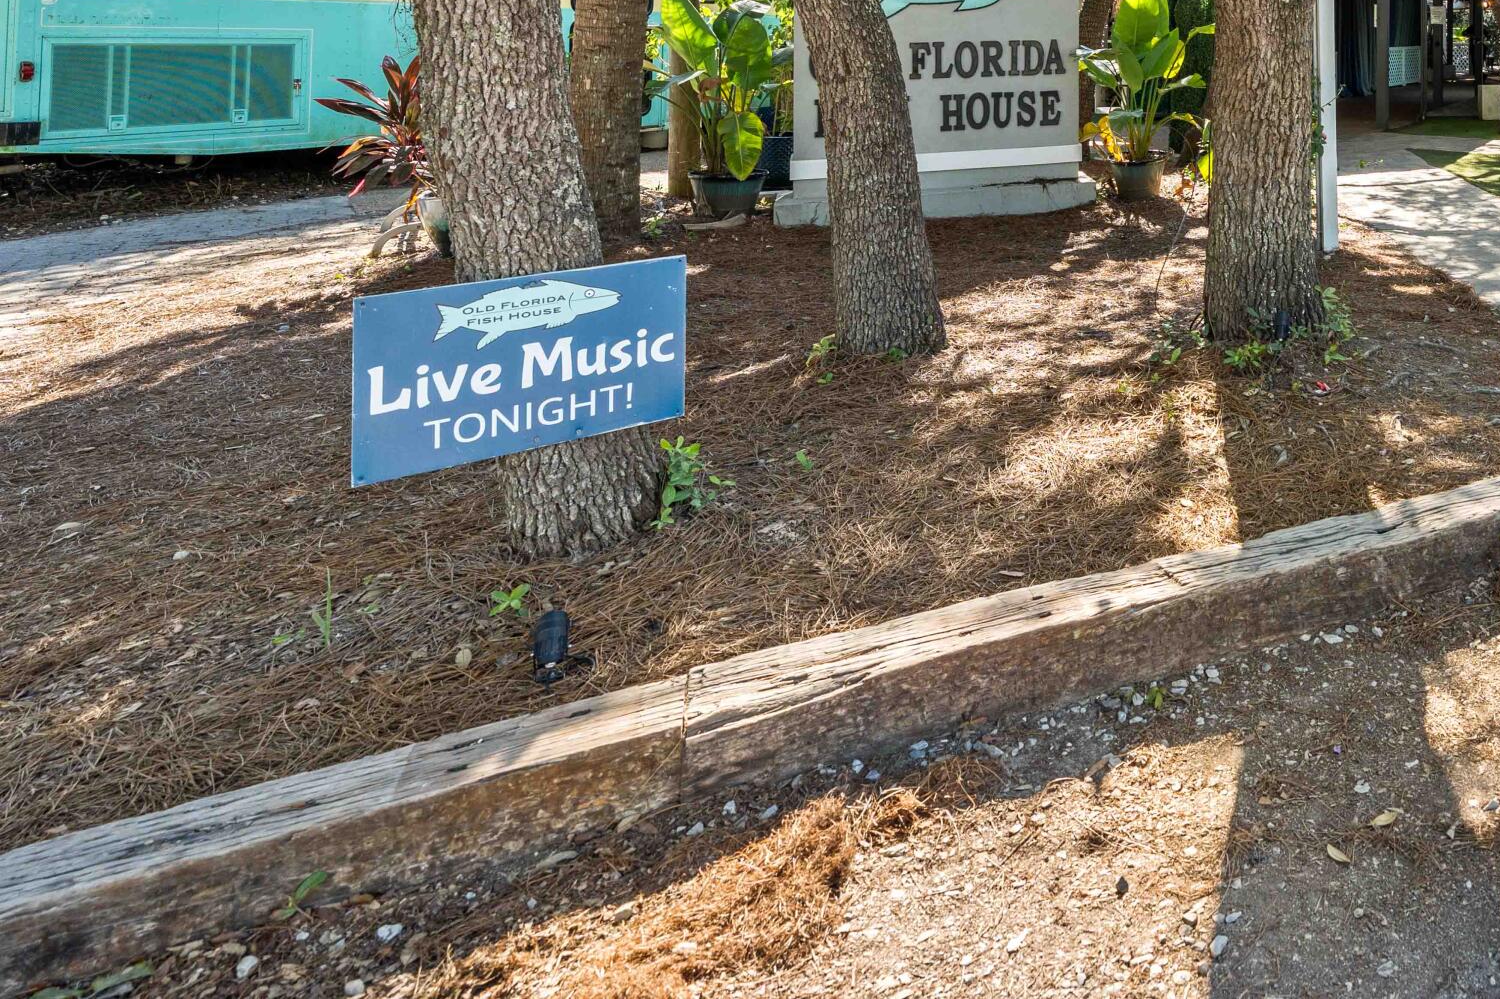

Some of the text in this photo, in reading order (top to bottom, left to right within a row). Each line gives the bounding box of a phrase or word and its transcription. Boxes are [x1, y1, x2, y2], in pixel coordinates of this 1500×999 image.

[909, 39, 1066, 80] FLORIDA
[940, 90, 1062, 132] HOUSE
[462, 294, 566, 315] OLD FLORIDA
[467, 307, 562, 327] FISH HOUSE
[367, 328, 675, 415] Live Music
[423, 382, 634, 449] TONIGHT!
